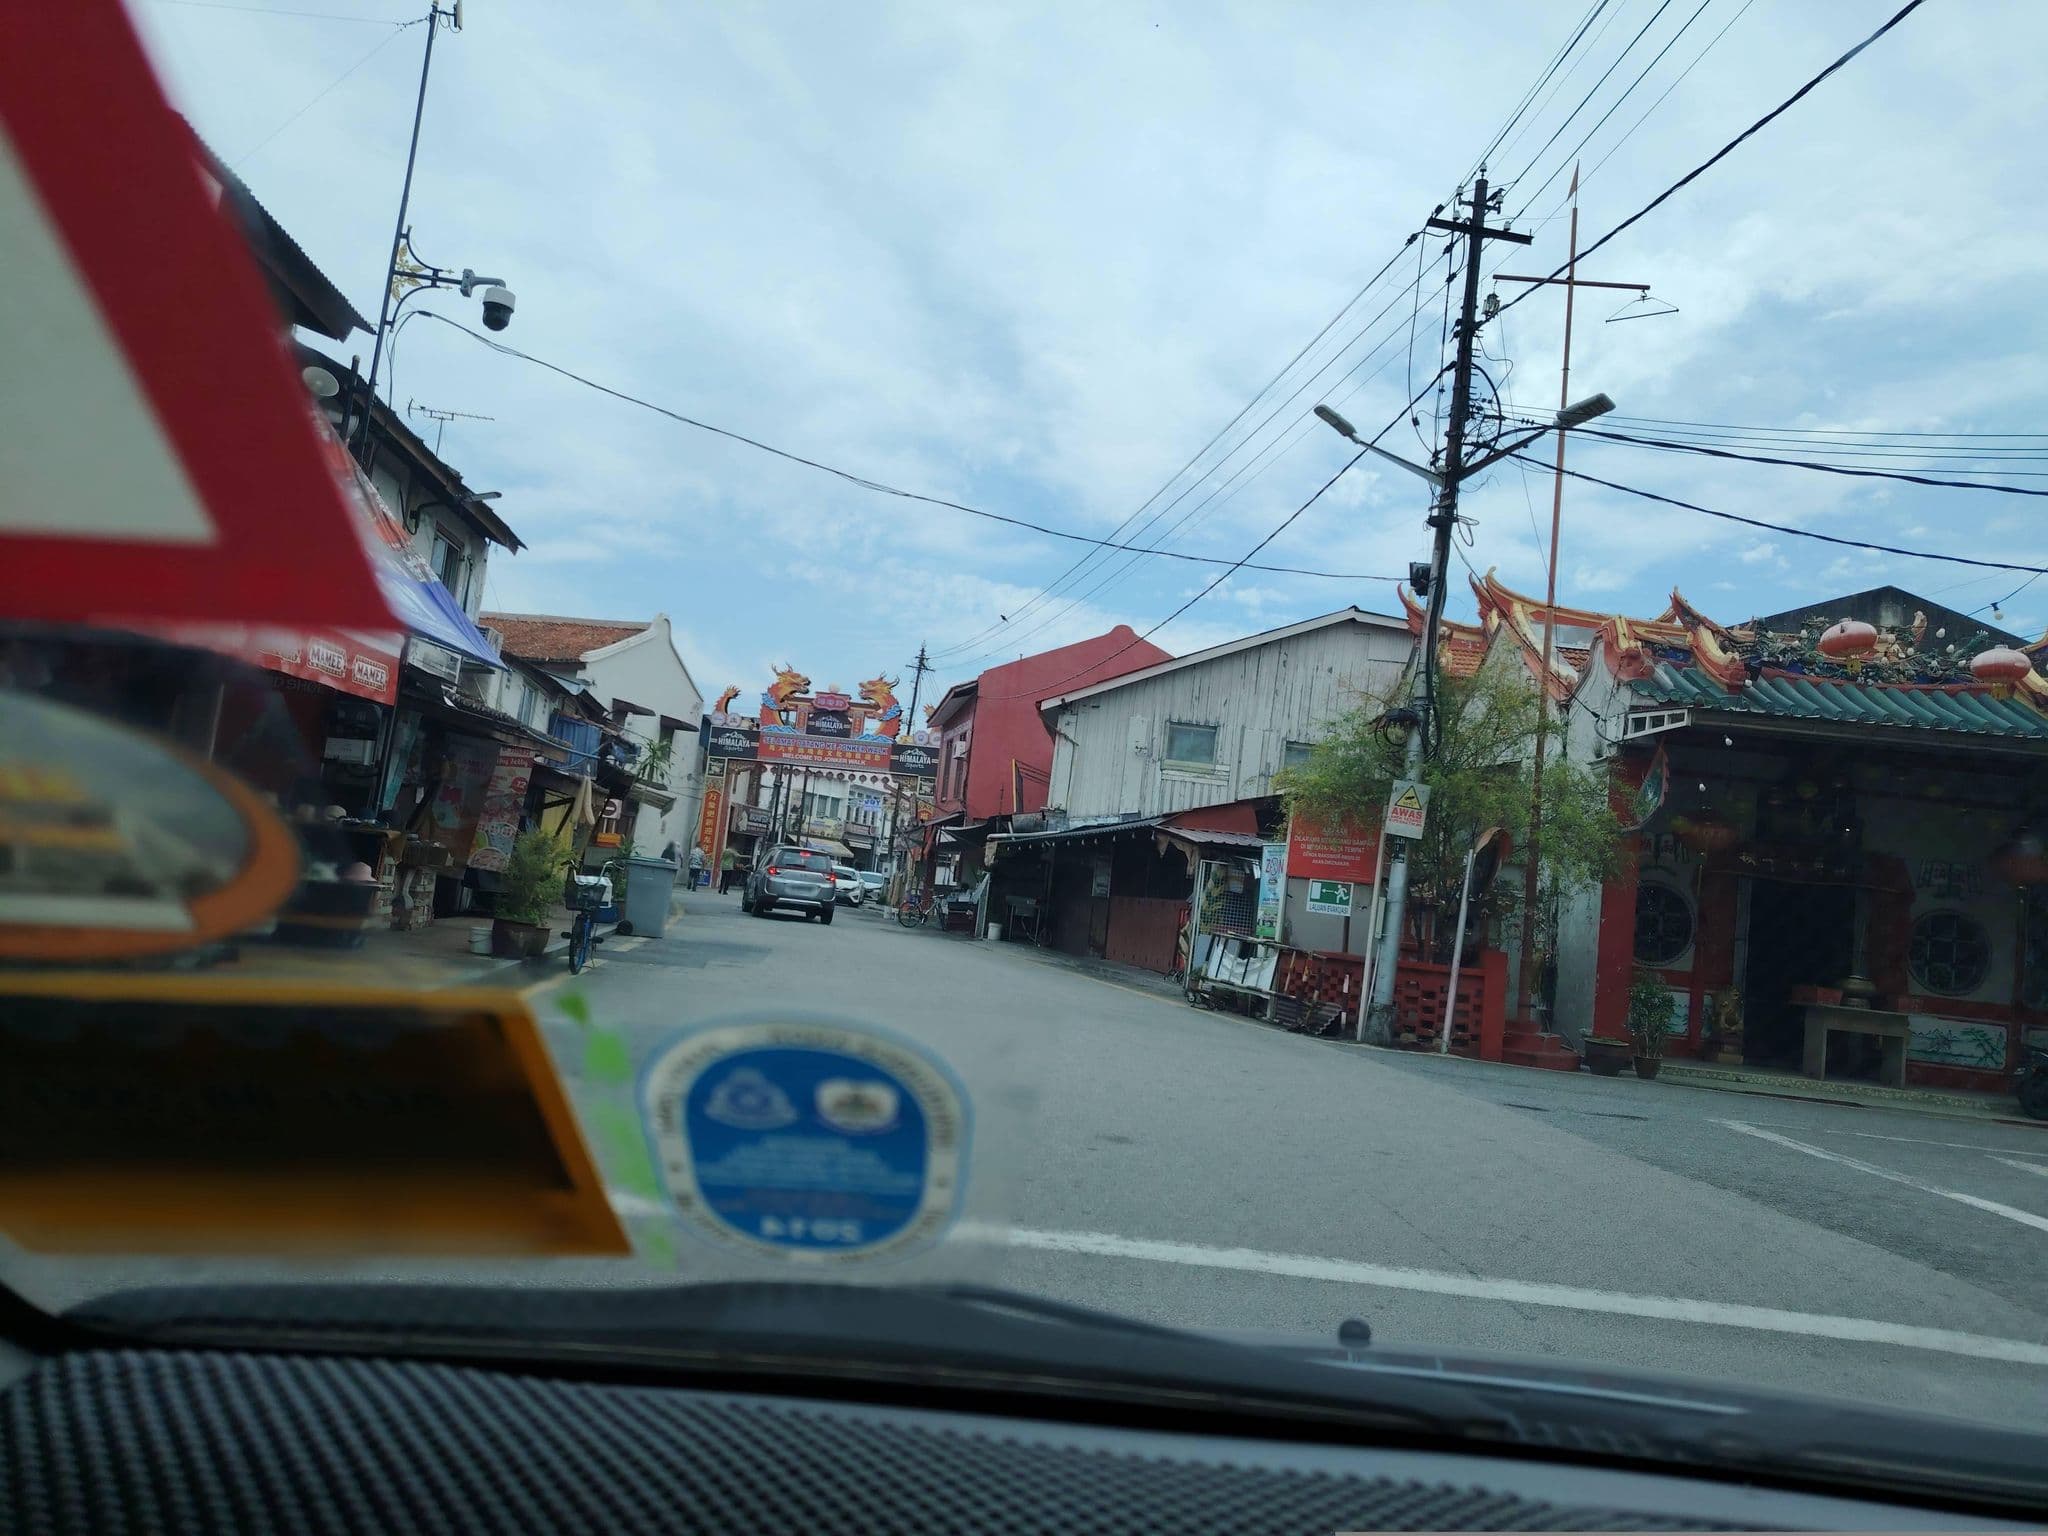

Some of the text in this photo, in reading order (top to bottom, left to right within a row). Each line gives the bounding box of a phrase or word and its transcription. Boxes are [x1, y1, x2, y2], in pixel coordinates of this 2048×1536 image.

[311, 647, 343, 670] MAMEE
[356, 665, 387, 685] MAMEE
[815, 720, 844, 730] HIMALAYA
[718, 737, 750, 748] HIMALAYA
[782, 752, 813, 761] WELCOME
[899, 754, 932, 766] HIMALAYA
[1391, 807, 1423, 820] AWAS
